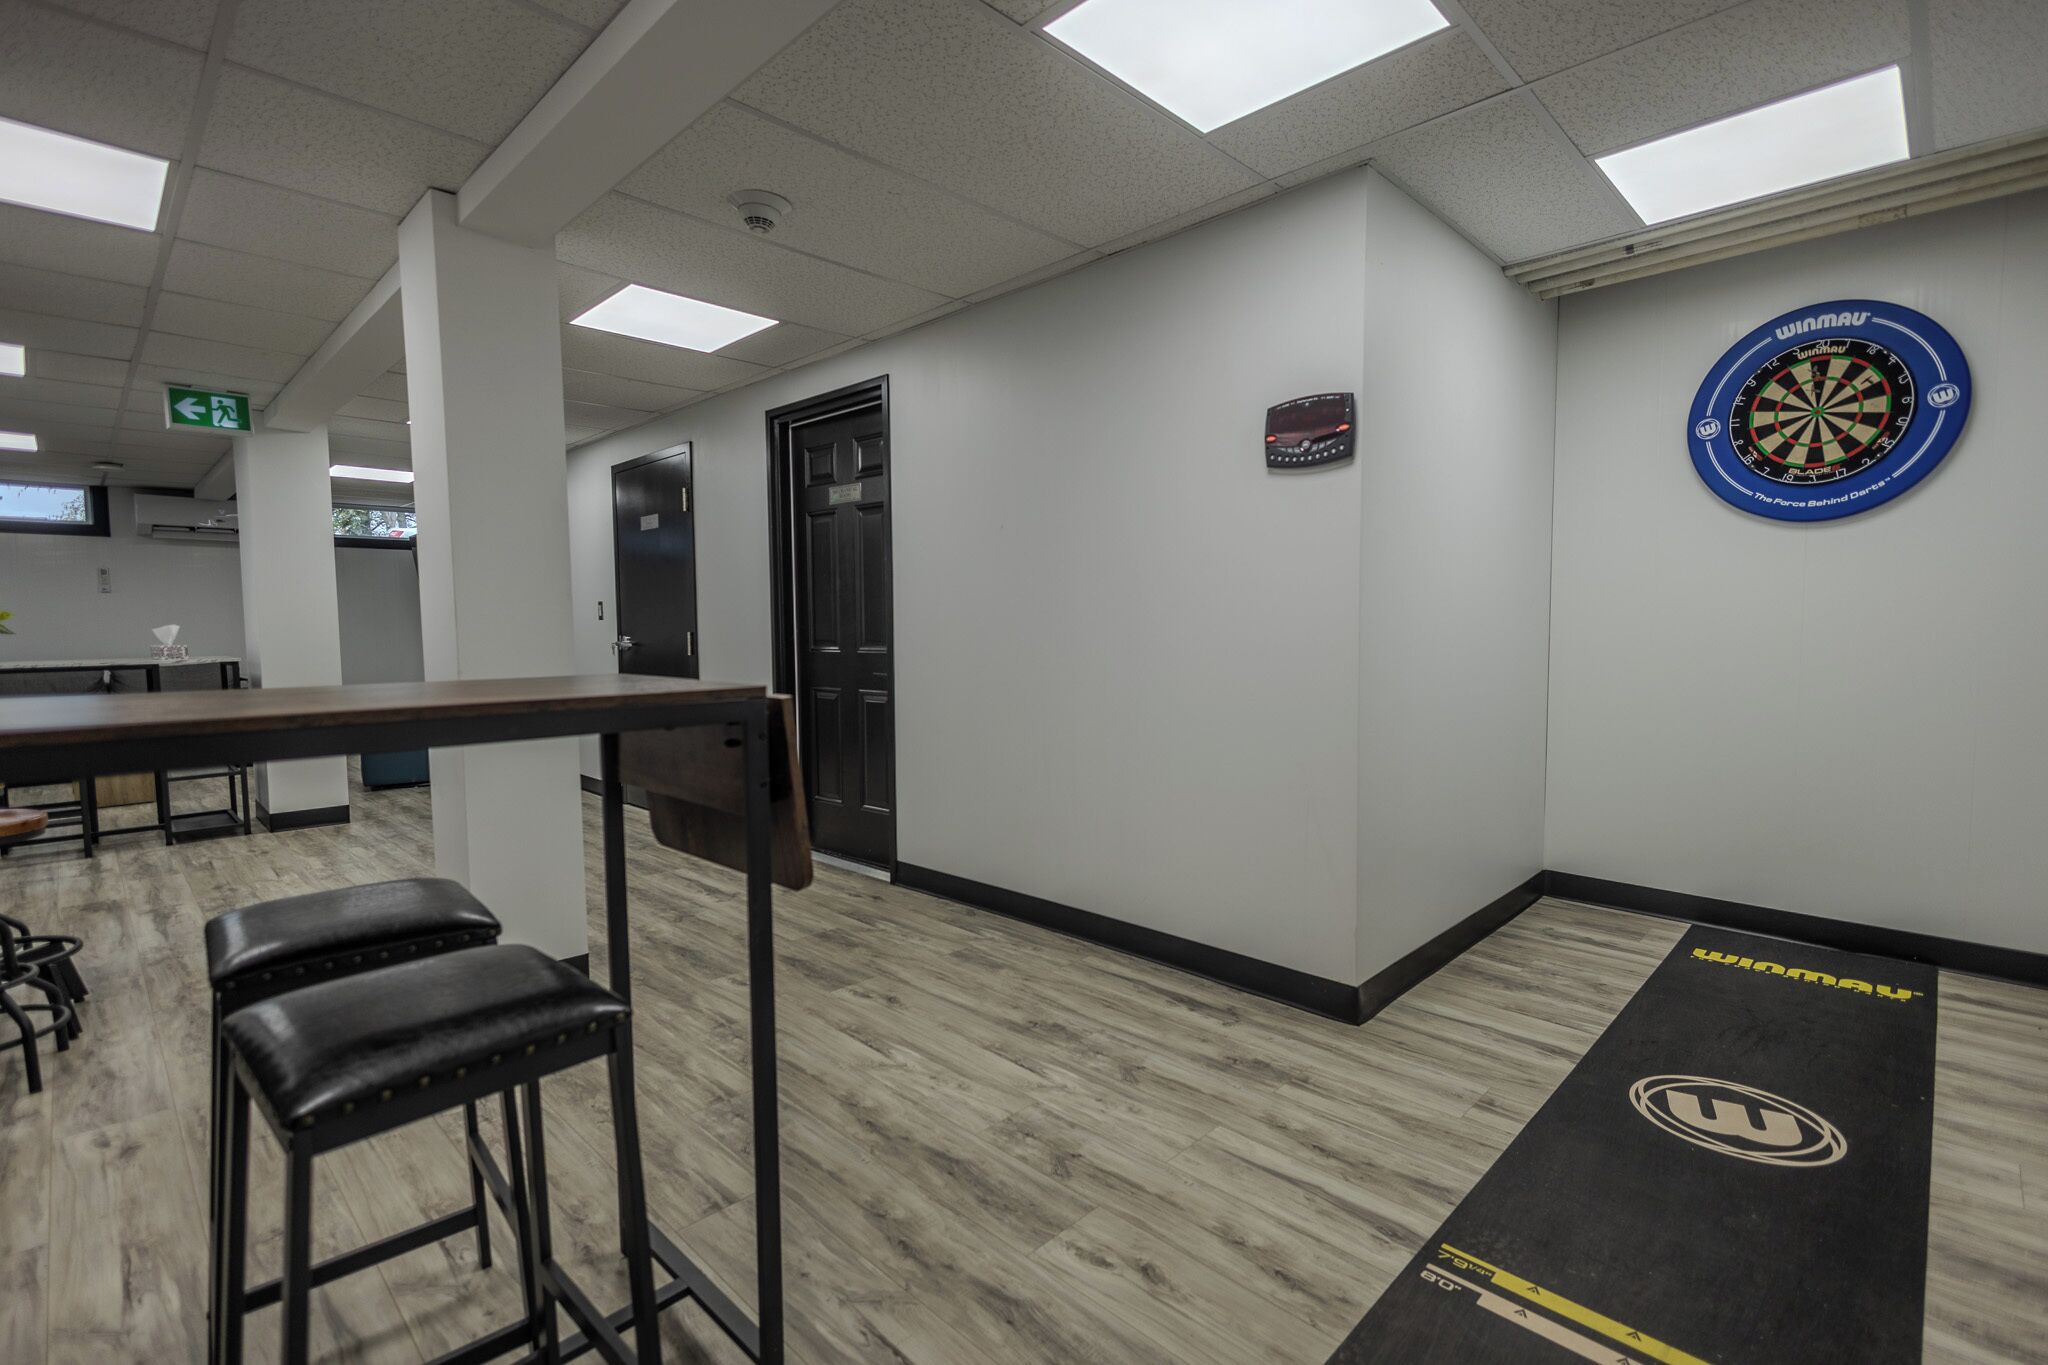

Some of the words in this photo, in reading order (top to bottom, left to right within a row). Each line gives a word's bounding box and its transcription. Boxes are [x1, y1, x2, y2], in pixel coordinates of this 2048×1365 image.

[1775, 312, 1867, 340] WINMAU
[1797, 345, 1847, 360] WINMAU
[1866, 343, 1880, 354] 18
[1754, 492, 1773, 503] The
[1773, 498, 1806, 507] Force
[1807, 494, 1849, 507] Behind
[1849, 481, 1886, 500] Darts
[1692, 947, 1912, 999] WINMAU
